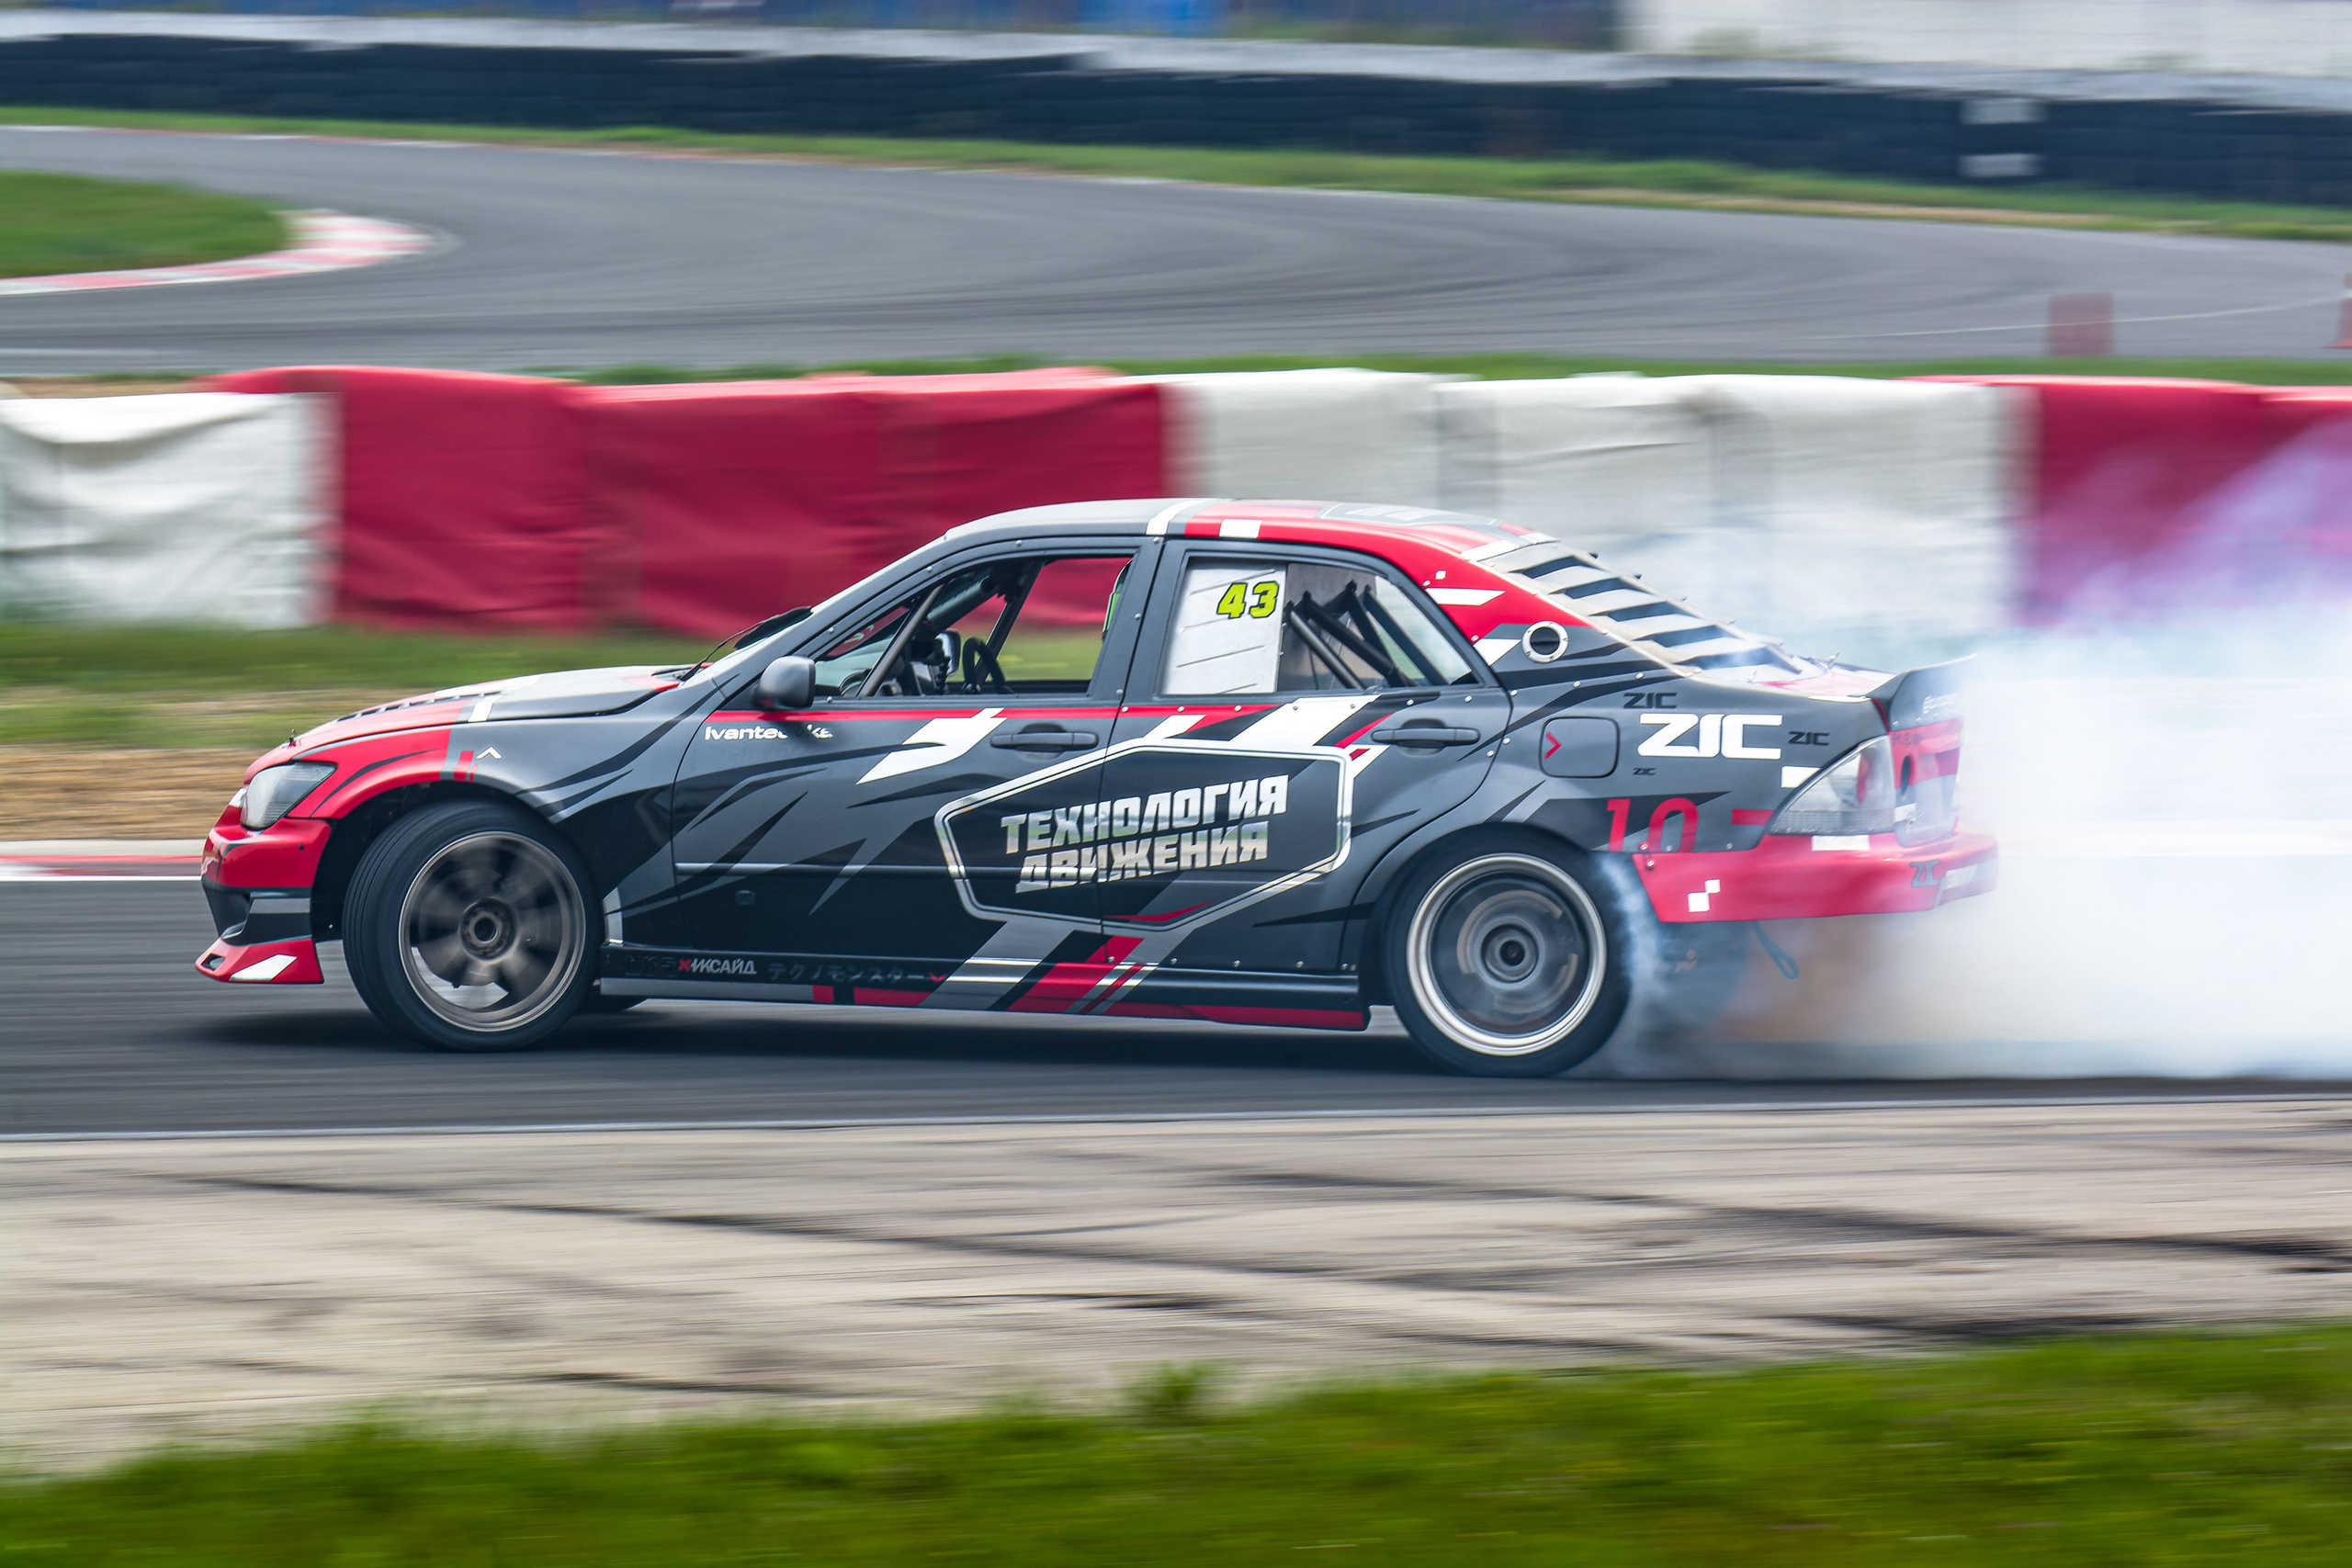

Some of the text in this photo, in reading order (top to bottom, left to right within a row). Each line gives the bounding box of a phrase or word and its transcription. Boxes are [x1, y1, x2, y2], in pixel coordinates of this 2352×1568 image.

[1216, 581, 1279, 619] 43
[1623, 692, 1678, 709] ZIC
[1637, 713, 1782, 760] ZIC
[1788, 731, 1830, 746] ZIC
[1633, 767, 1656, 776] ZIC
[1001, 774, 1289, 854] ТЕХНОЛОГИЯ
[1015, 820, 1269, 894] ДВИЖЕНИЯ
